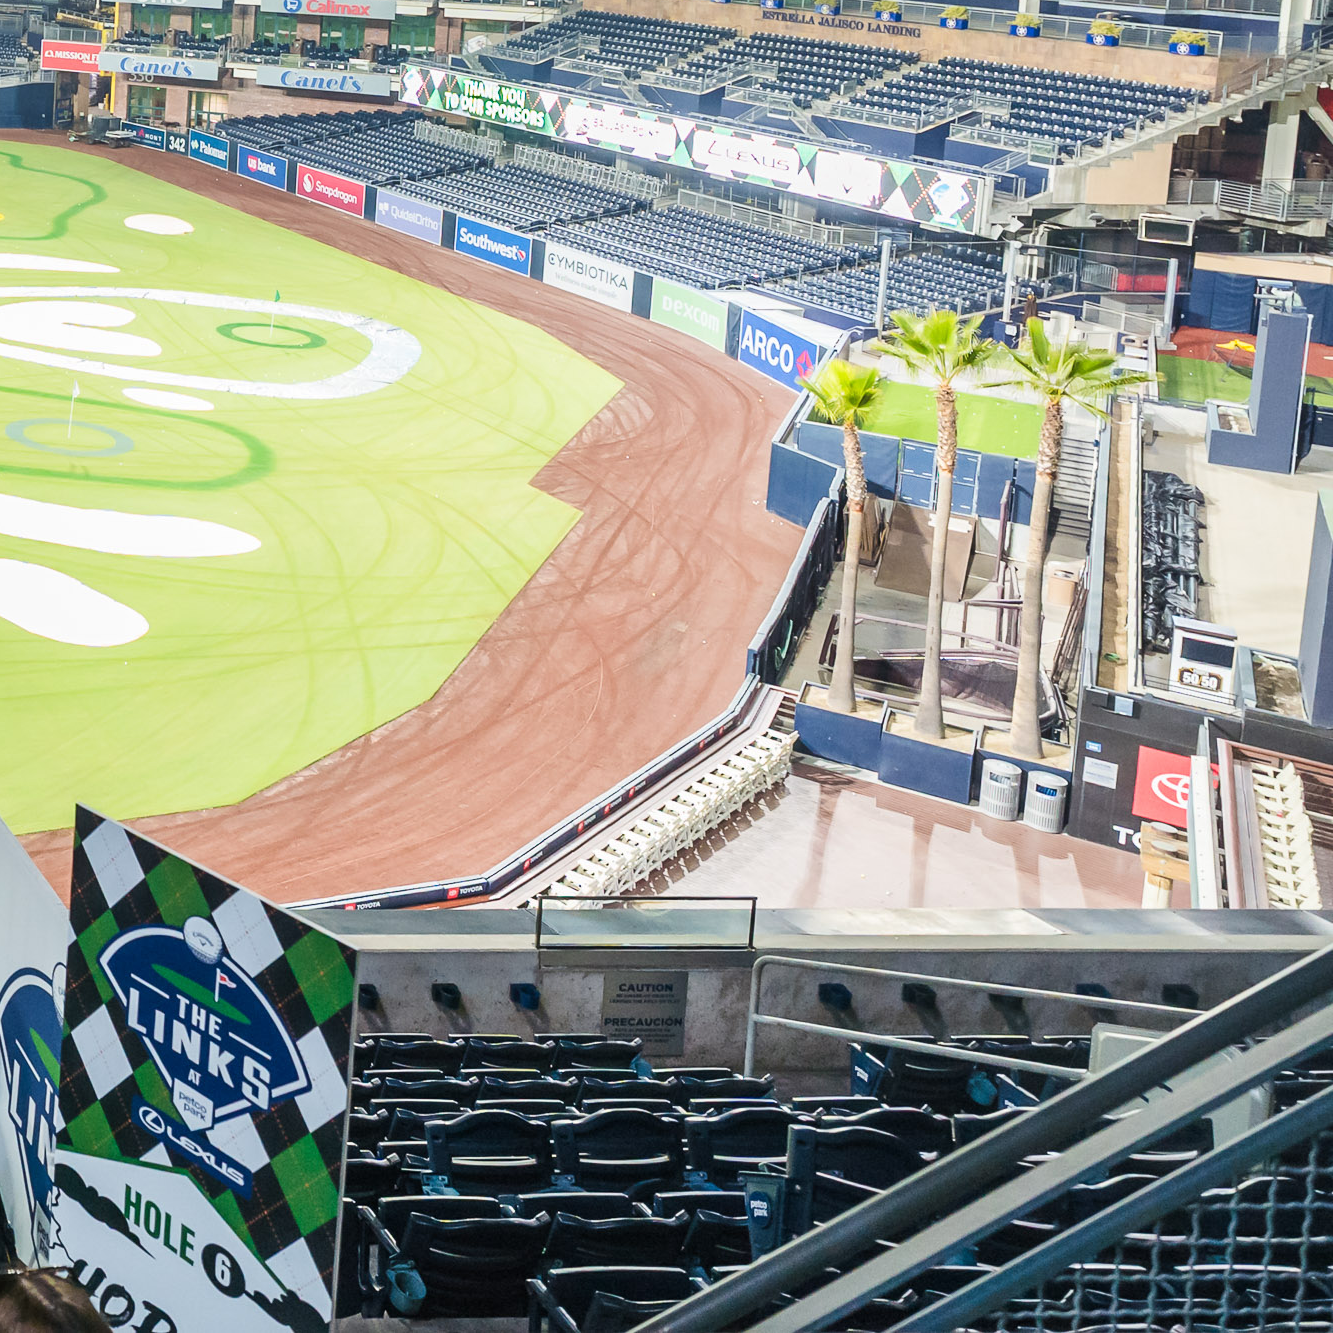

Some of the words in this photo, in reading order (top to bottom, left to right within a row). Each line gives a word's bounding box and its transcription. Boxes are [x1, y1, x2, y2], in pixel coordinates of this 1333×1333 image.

[306, 0, 371, 17] Calimax
[762, 10, 815, 25] ESTRELLA
[818, 16, 865, 31] JALISCO
[868, 22, 921, 38] LANDING
[54, 50, 90, 61] MISSION
[120, 57, 194, 77] Canel's
[281, 70, 363, 93] Canel's
[463, 79, 501, 100] THANK
[502, 87, 526, 108] YOU
[445, 92, 459, 109] TO
[460, 95, 484, 116] OUR
[485, 102, 545, 128] SPONSORS
[169, 136, 186, 152] 342
[199, 141, 228, 161] Palomar
[726, 150, 790, 172] LEXUS
[315, 180, 358, 205] Snapdragon
[391, 206, 439, 230] QuidelOrtho
[459, 228, 519, 260] Southwest
[547, 253, 629, 291] CYMBIOTIKA
[741, 325, 794, 374] ARCO
[460, 885, 483, 896] TOYOTA
[356, 901, 381, 911] TOYOTA
[619, 984, 673, 992] CAUTION
[175, 994, 223, 1042] THE
[604, 1017, 683, 1027] PRECAUCIÓN
[127, 987, 271, 1111] LINKS
[188, 1068, 202, 1086] AT
[179, 1090, 207, 1114] petco
[183, 1102, 207, 1122] park
[10, 1059, 56, 1182] LIN
[167, 1127, 245, 1186] LEXUS
[750, 1199, 768, 1209] petco
[754, 1208, 768, 1218] park
[124, 1183, 196, 1267] HOLE
[215, 1253, 232, 1287] 6
